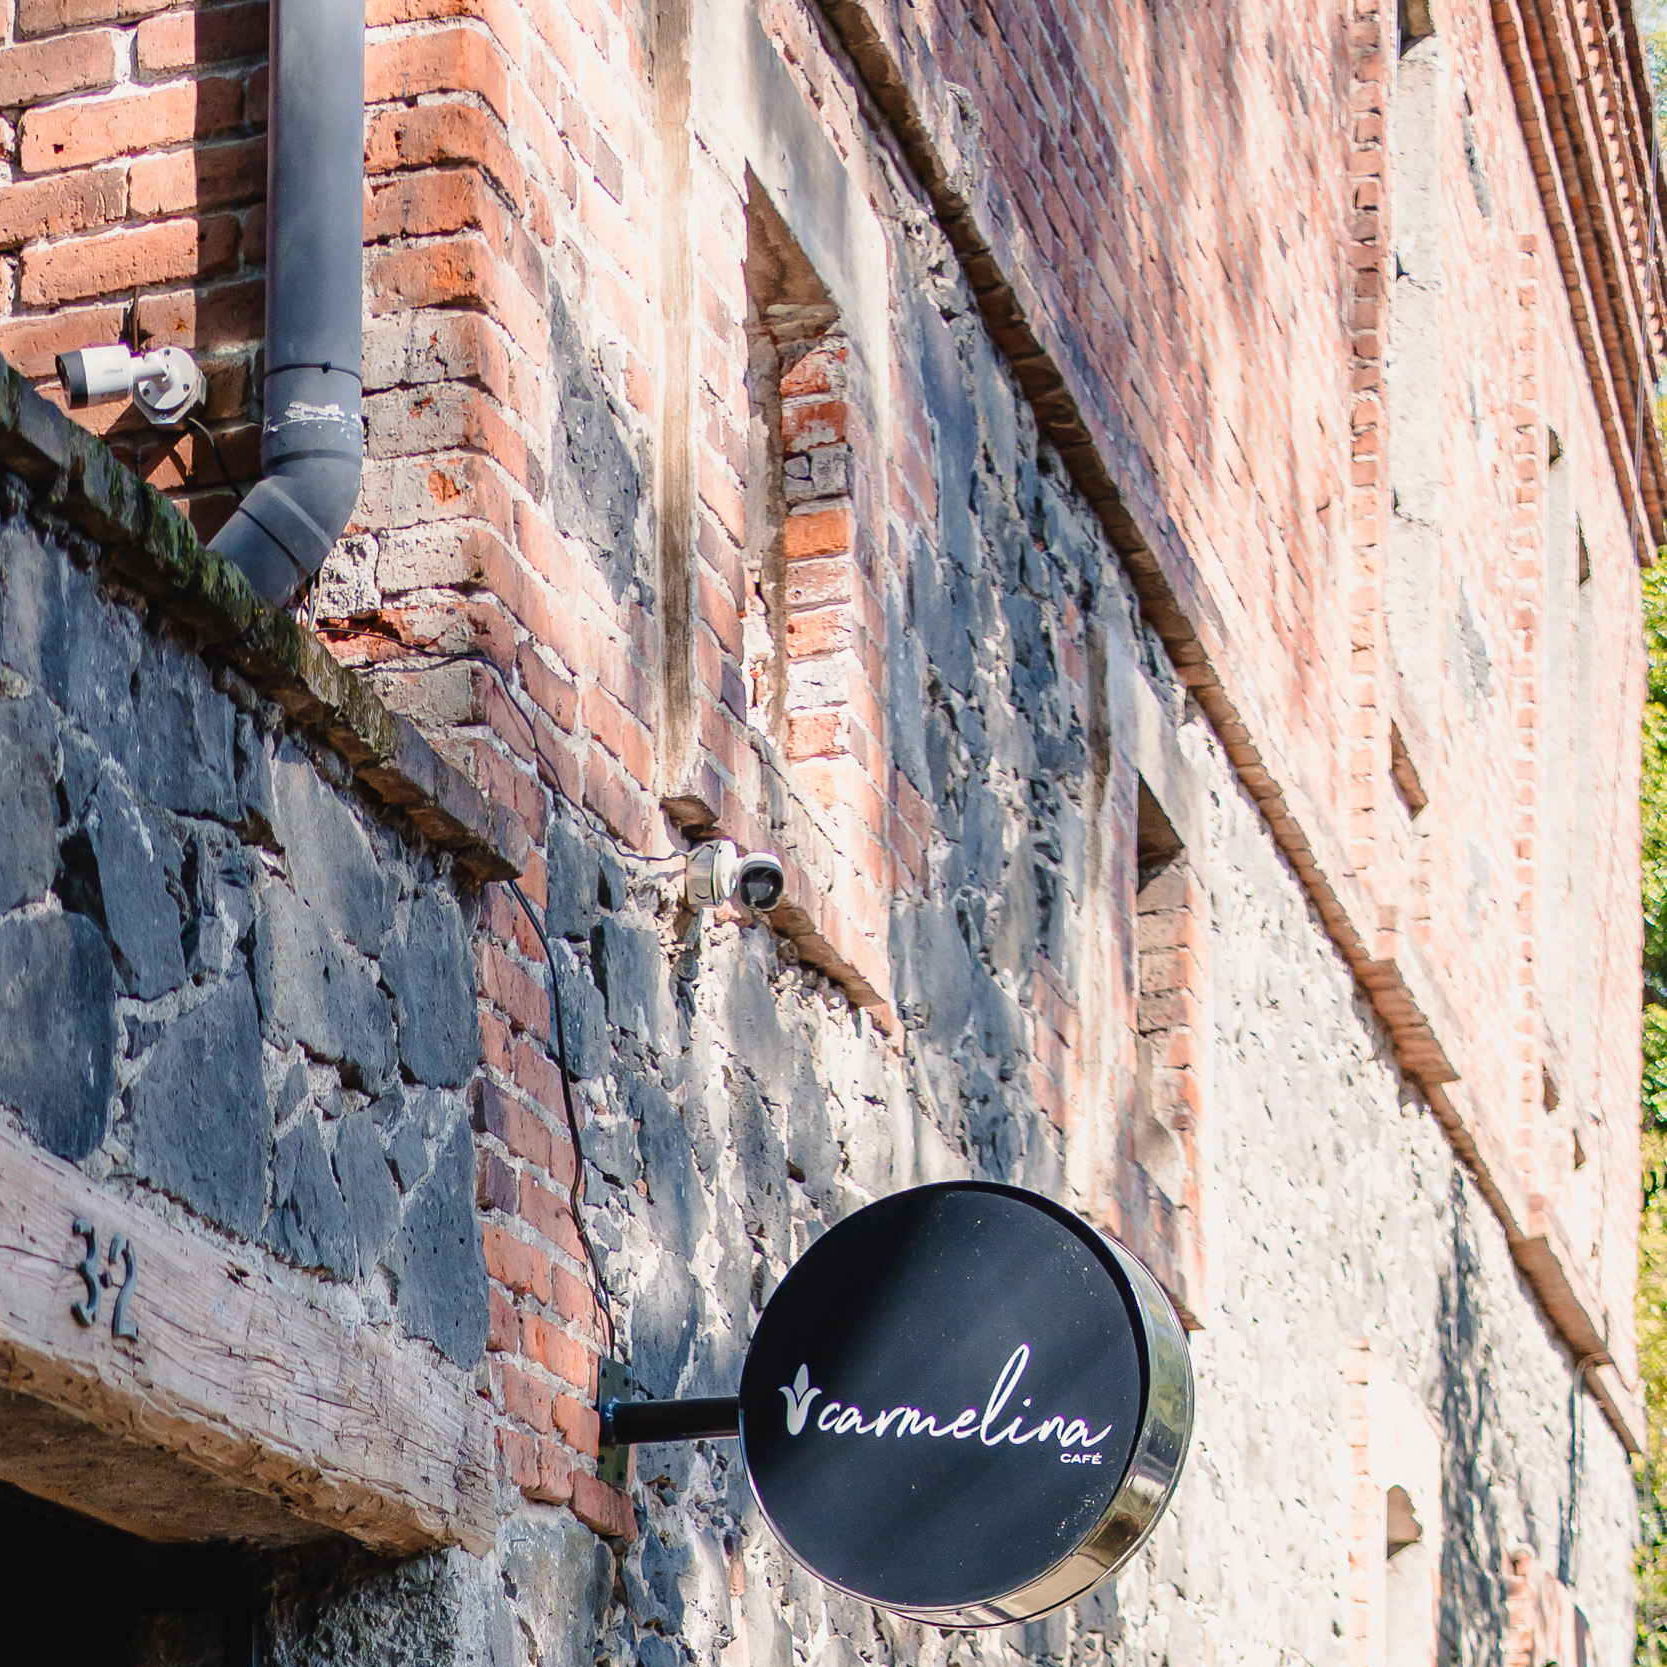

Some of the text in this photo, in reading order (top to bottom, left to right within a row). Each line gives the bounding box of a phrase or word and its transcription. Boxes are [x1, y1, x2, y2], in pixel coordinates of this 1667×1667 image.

[70, 1217, 139, 1344] 32
[816, 1343, 1113, 1448] carmelina
[1060, 1452, 1102, 1465] CAFÉ
